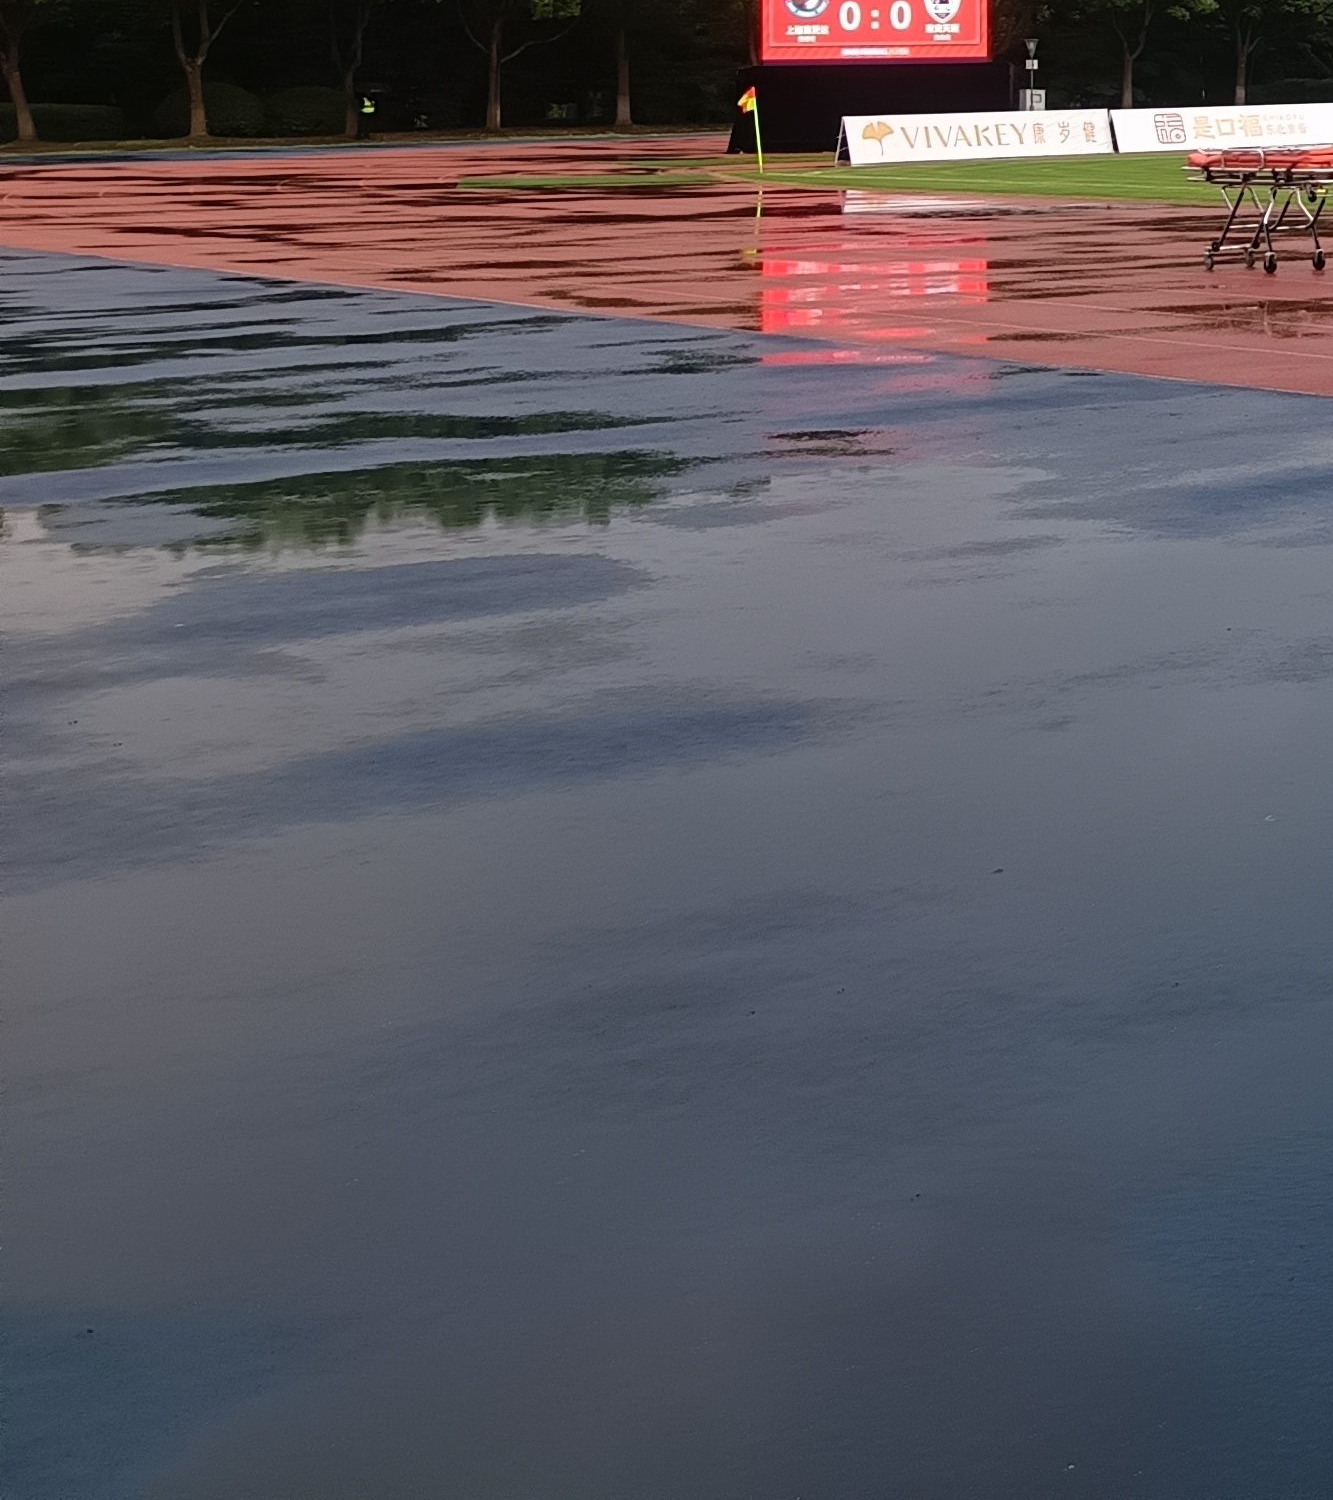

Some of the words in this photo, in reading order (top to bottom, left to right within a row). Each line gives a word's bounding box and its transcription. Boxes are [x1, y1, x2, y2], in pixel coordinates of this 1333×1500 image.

[900, 122, 1027, 149] VIVAKEY
[1193, 114, 1264, 140] 是口福
